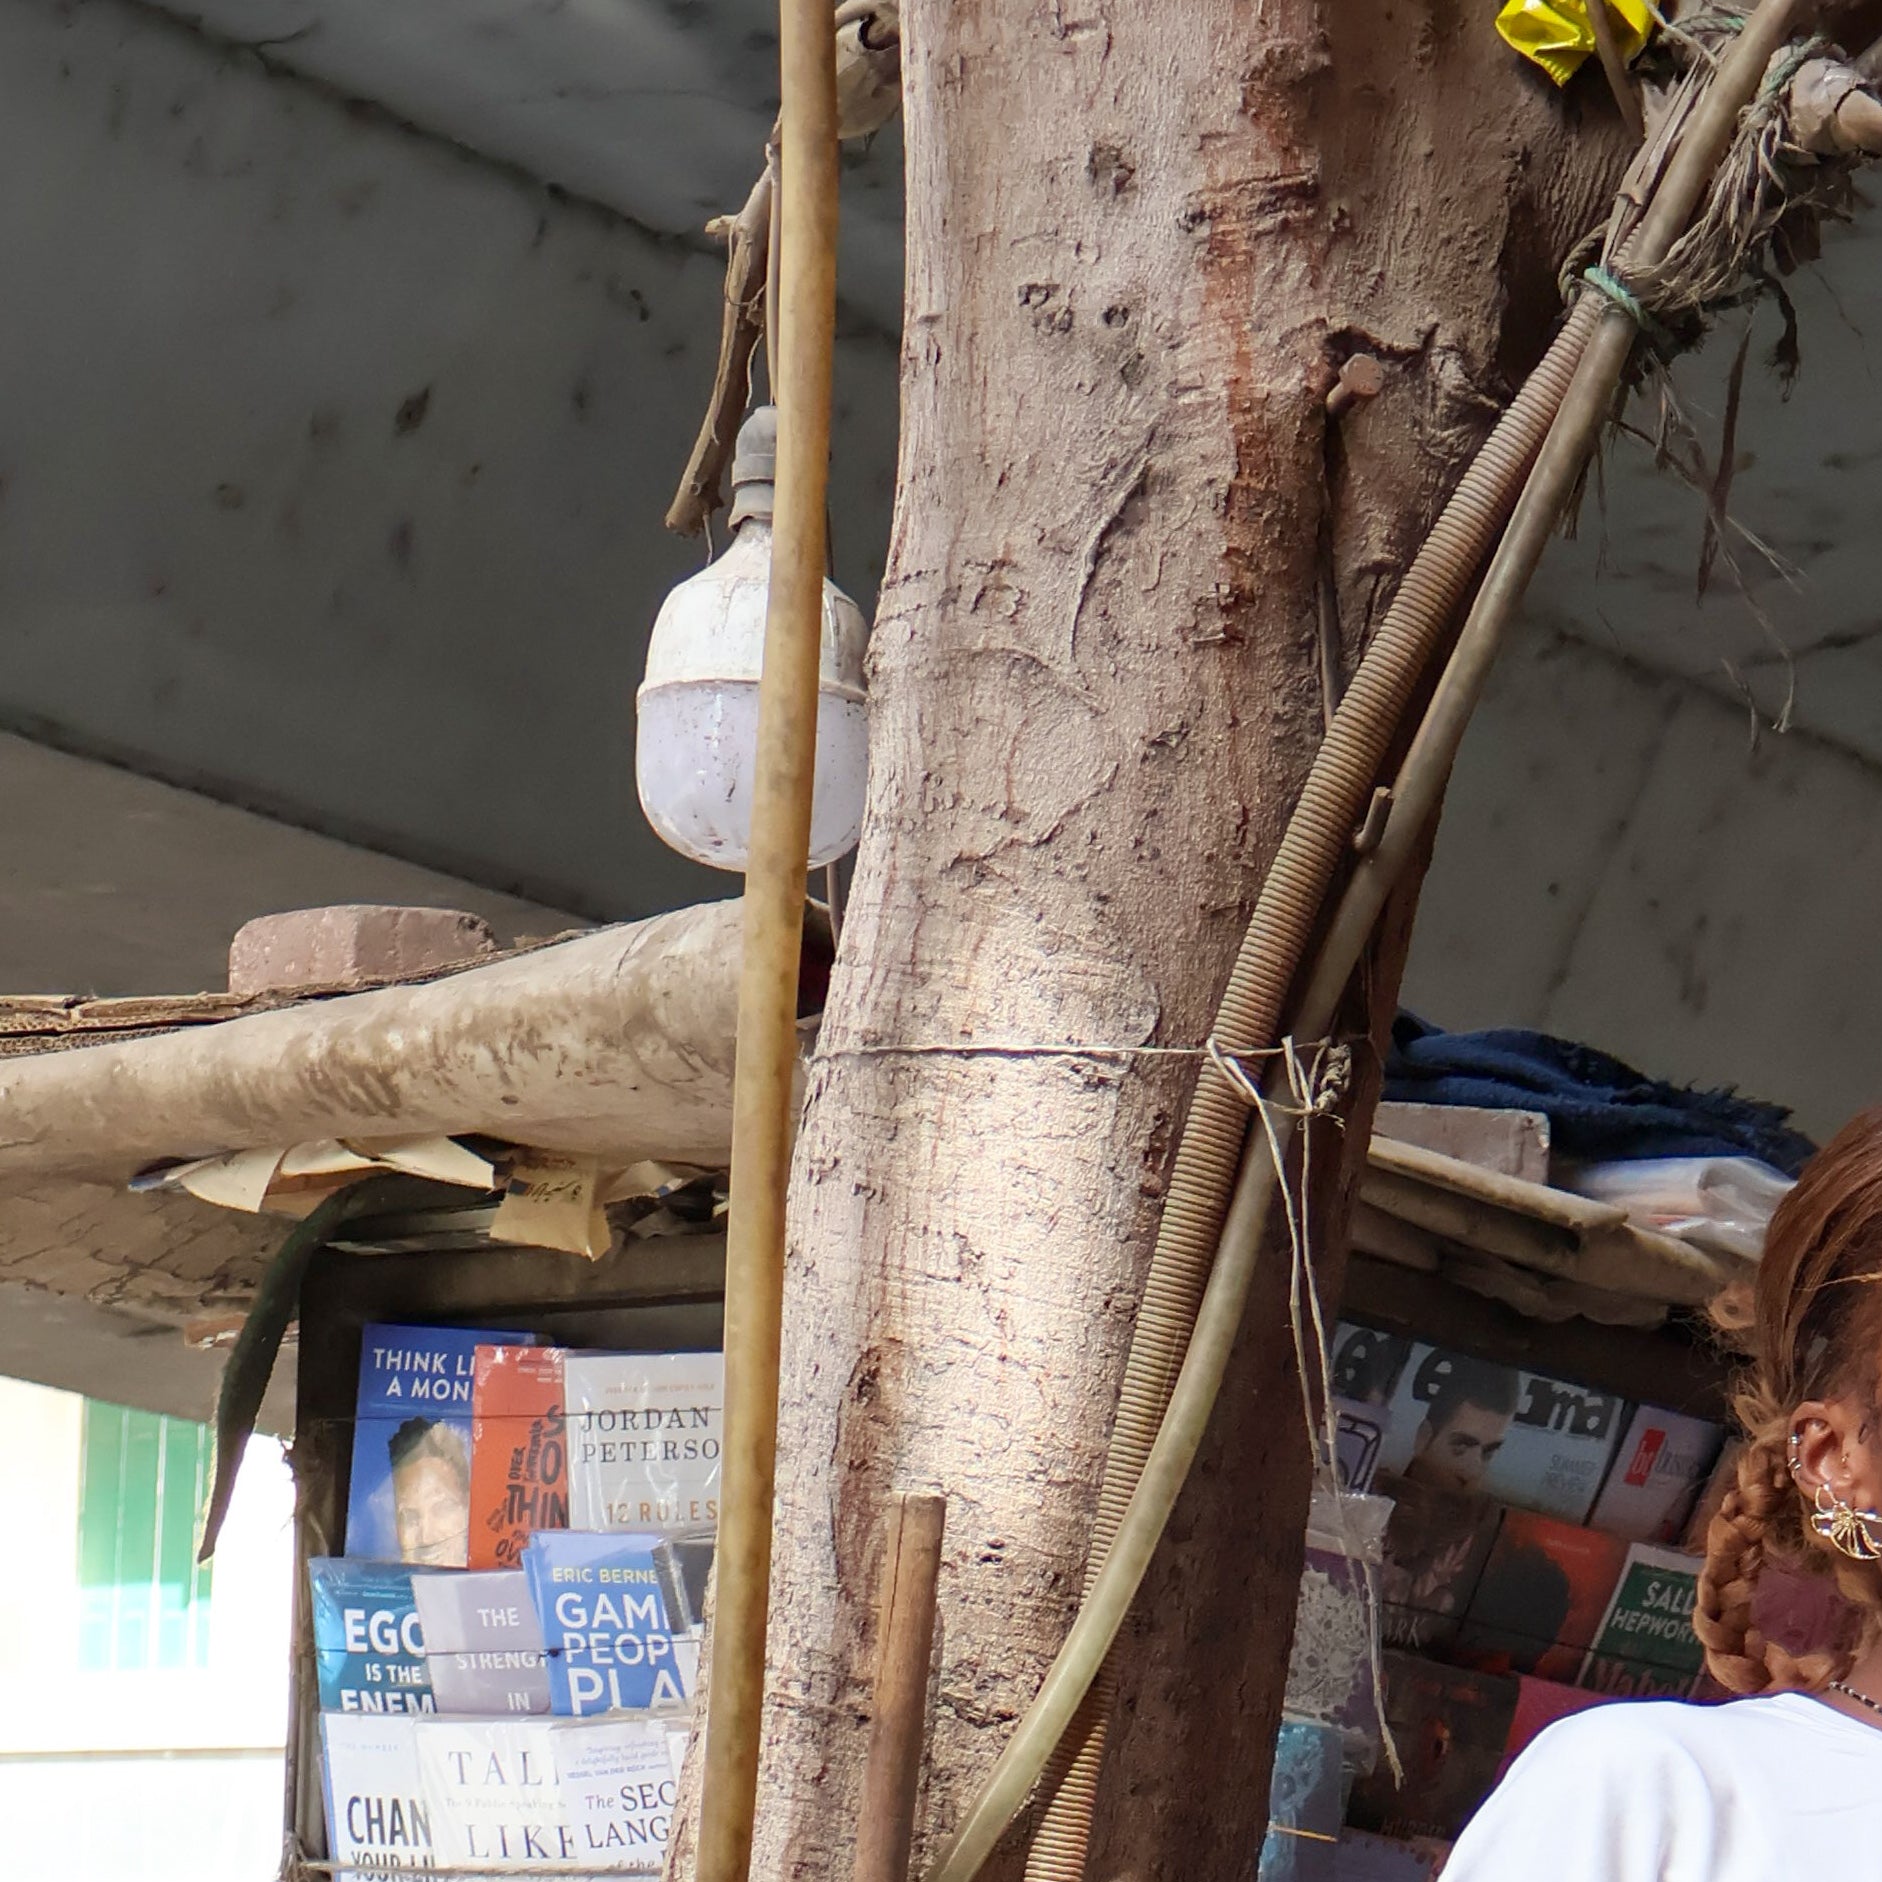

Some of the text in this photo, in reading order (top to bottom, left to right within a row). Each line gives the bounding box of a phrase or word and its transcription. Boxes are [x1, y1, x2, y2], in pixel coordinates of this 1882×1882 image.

[373, 1349, 447, 1375] THINK
[387, 1376, 474, 1400] A MON
[583, 1407, 711, 1432] JORDAN
[583, 1439, 720, 1464] PETERSO
[607, 1500, 718, 1522] 12 RULES
[553, 1568, 658, 1584] ERIC BERNE
[1641, 1581, 1695, 1613] SALL
[478, 1608, 520, 1627] THE
[555, 1594, 670, 1630] GAM
[1610, 1607, 1697, 1641] HEPWOR
[344, 1608, 425, 1654] EGO
[456, 1651, 550, 1671] STRENG
[563, 1633, 670, 1665] PEOP
[365, 1665, 422, 1684] IS THE
[340, 1690, 432, 1714] ENEM
[507, 1693, 530, 1711] IN
[568, 1667, 685, 1715] PLA
[448, 1750, 560, 1786] TAL
[585, 1795, 614, 1812] The
[347, 1796, 433, 1847] CHAN
[467, 1825, 577, 1860] LIKE
